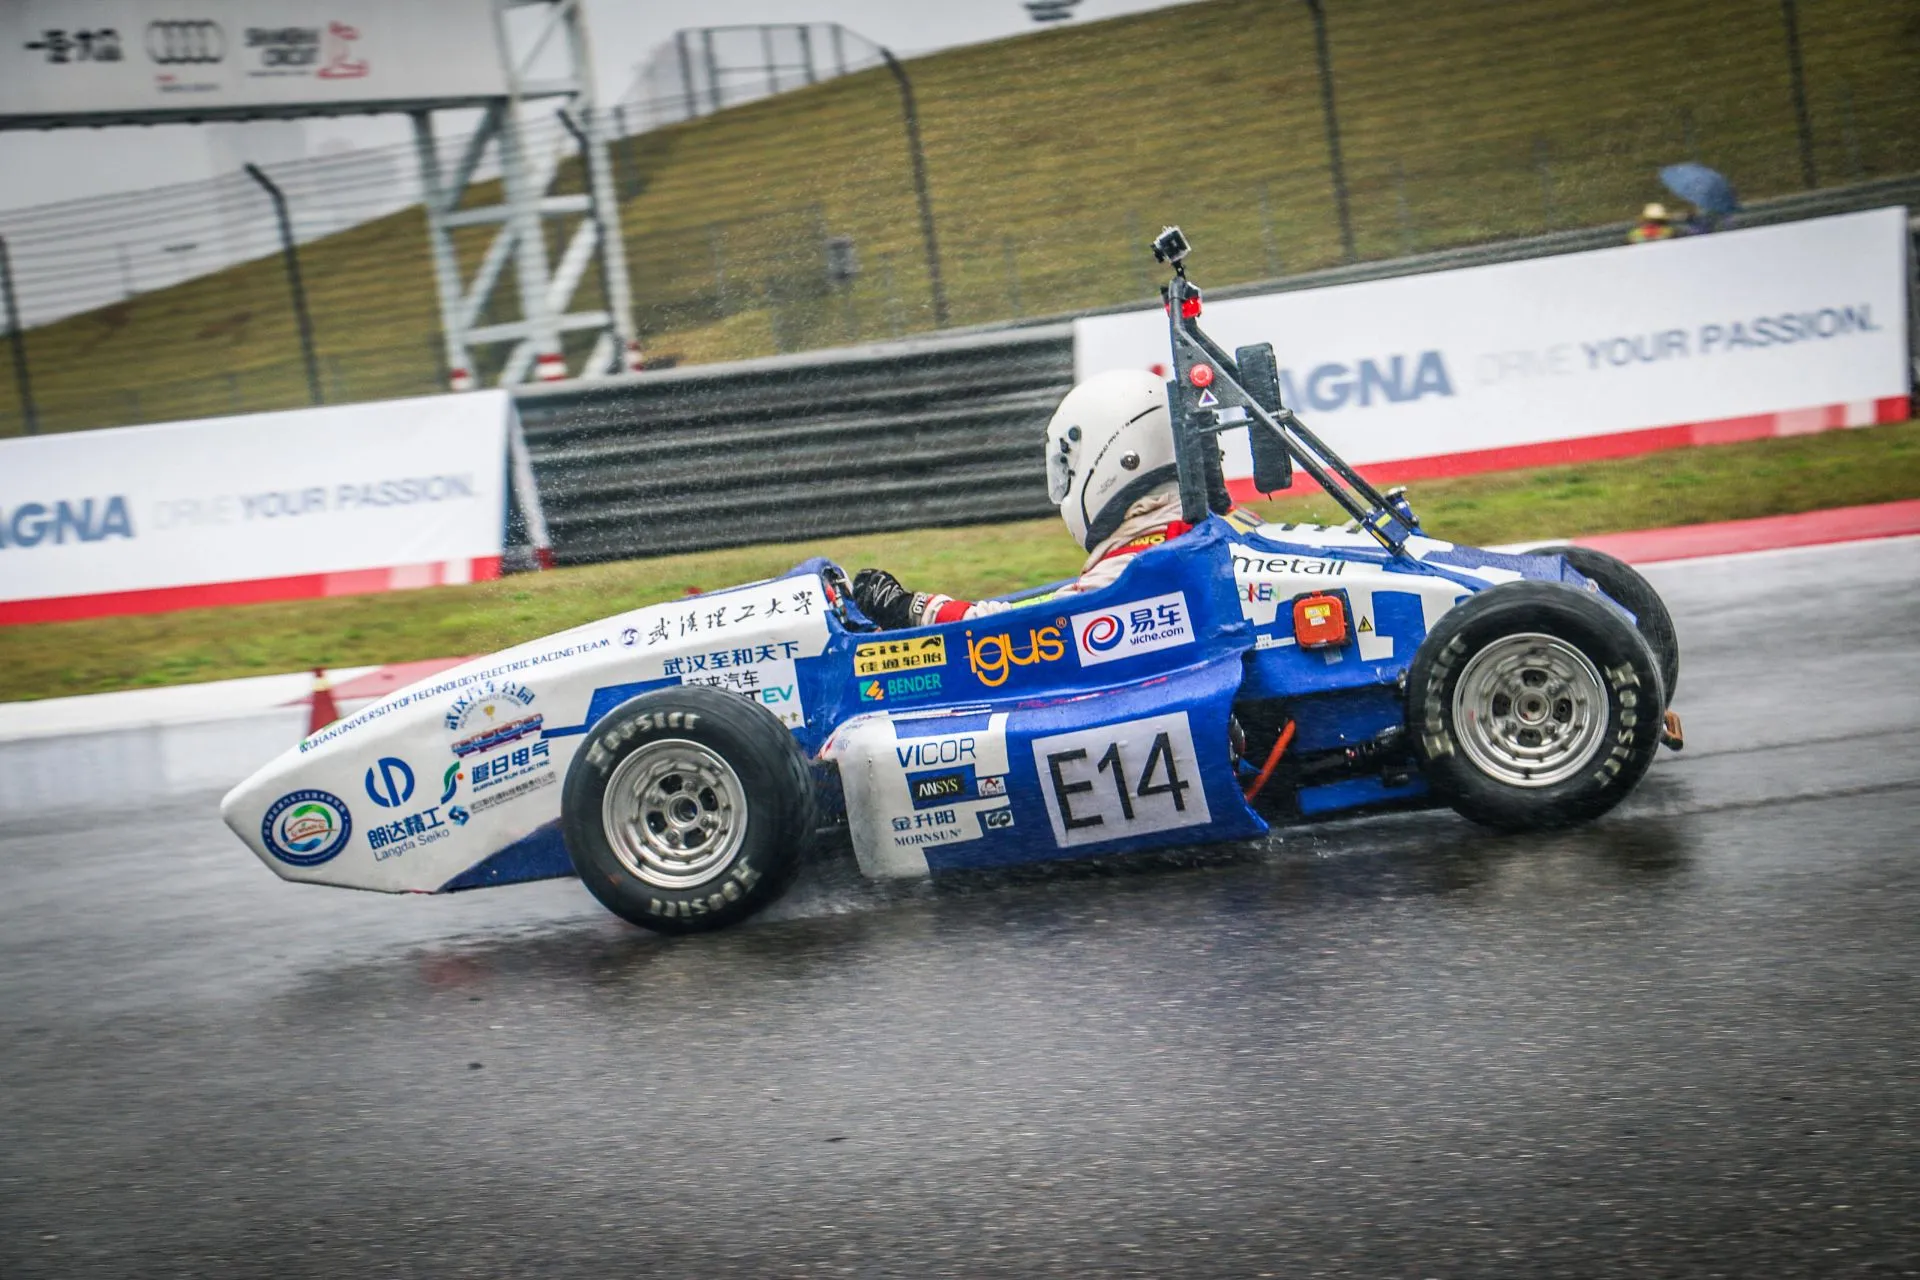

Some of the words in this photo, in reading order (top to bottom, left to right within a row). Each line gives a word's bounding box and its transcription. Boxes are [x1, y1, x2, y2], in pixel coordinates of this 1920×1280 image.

[1580, 329, 1690, 368] YOUR
[1698, 303, 1882, 353] PASSION.
[238, 488, 326, 520] YOUR
[1233, 554, 1346, 577] metall
[1131, 603, 1182, 635] 易车
[663, 641, 799, 676] 武汉至和天下
[856, 642, 909, 658] Giti
[861, 653, 941, 673] 佳通轮胎
[300, 730, 337, 753] WUHAN
[338, 700, 400, 735] UNIVERSITY
[400, 696, 412, 708] OF
[412, 673, 479, 702] TECHNOLOGY
[480, 659, 531, 680] ELECTRIC
[532, 648, 575, 666] RACING
[576, 638, 610, 654] TEAM
[888, 673, 942, 695] BENDER
[472, 740, 549, 784] 追日电气
[896, 737, 976, 768] VICOR
[918, 777, 959, 797] ANSYS
[1047, 732, 1190, 830] E14
[367, 807, 446, 850] 朗达精工
[892, 810, 956, 831] 金升阳
[374, 841, 416, 862] Langda
[418, 829, 450, 846] Seiko
